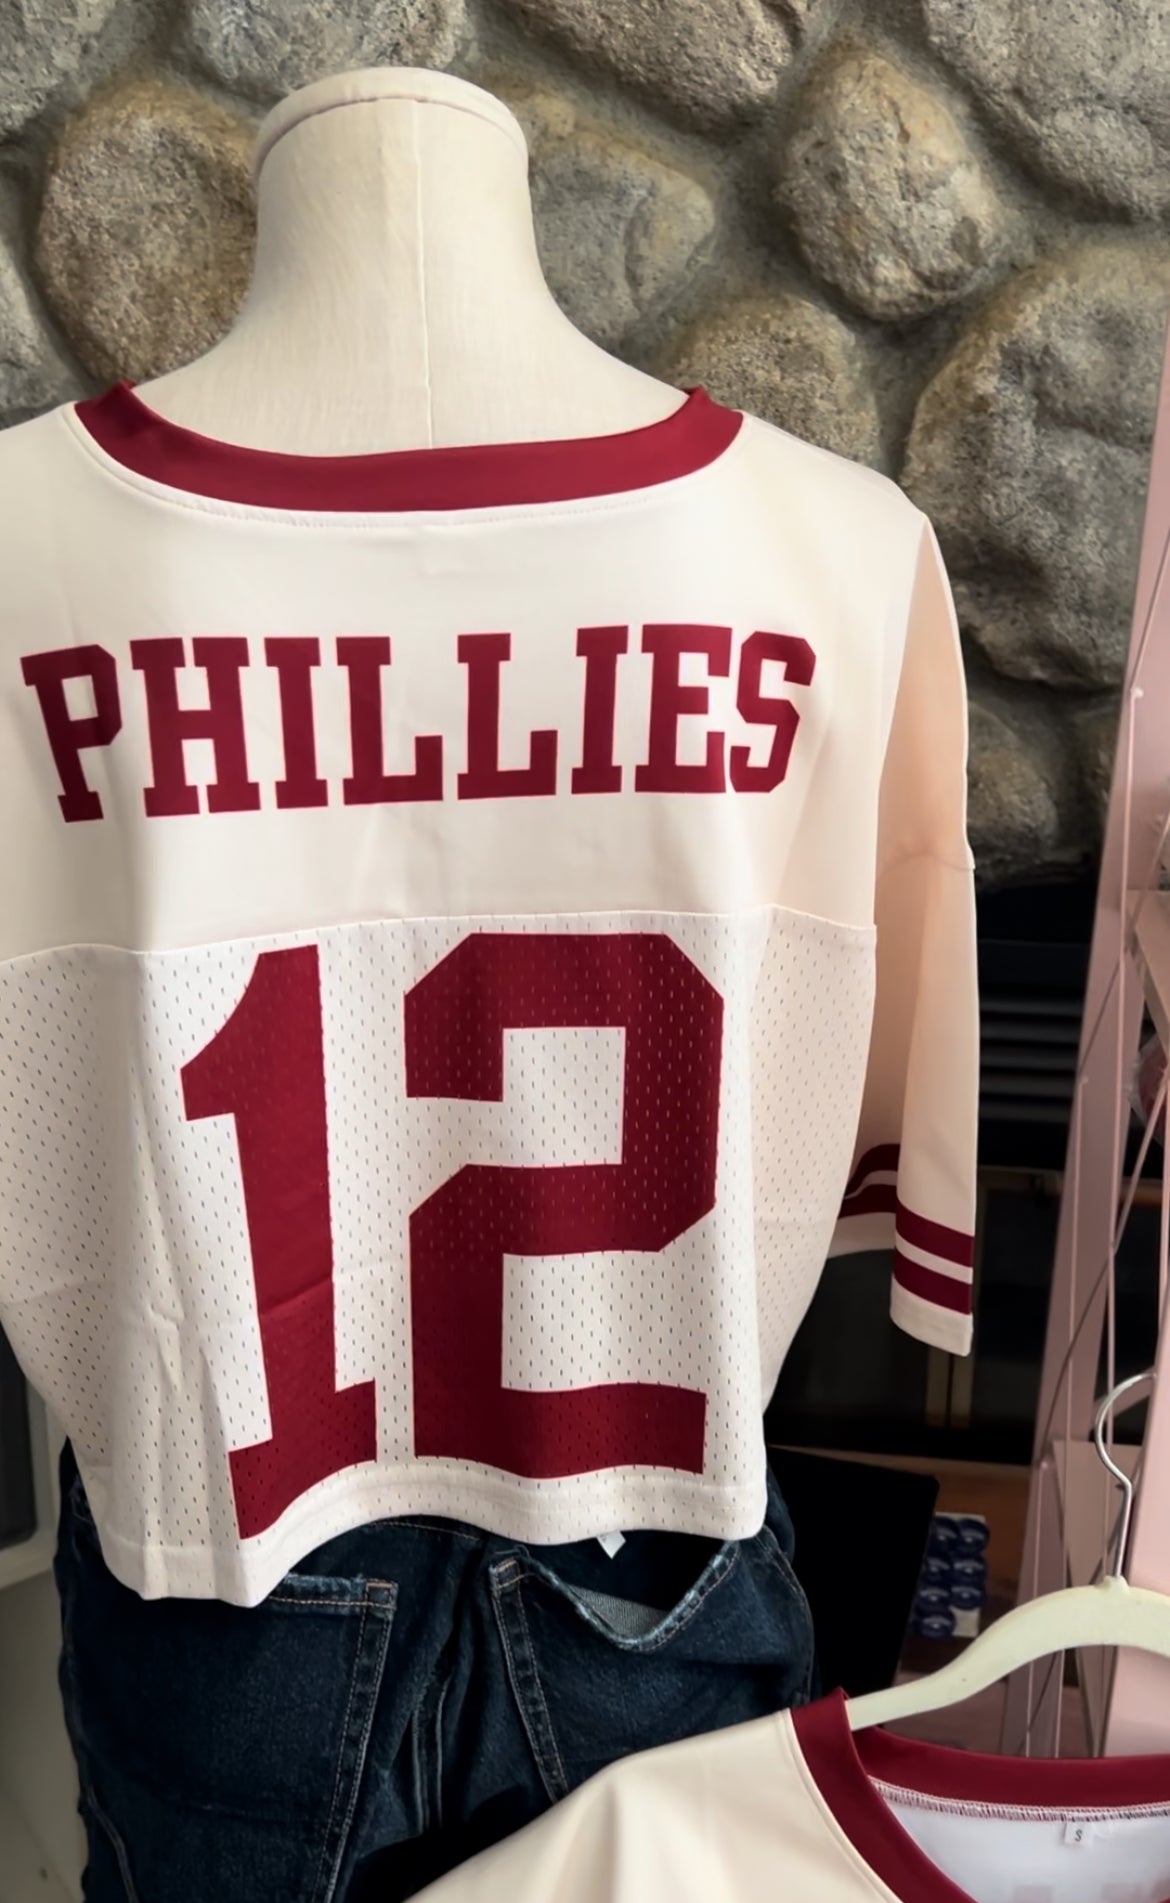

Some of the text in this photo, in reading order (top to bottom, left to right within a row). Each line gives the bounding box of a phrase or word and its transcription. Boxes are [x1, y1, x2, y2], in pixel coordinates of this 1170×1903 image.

[20, 624, 815, 823] PHILLIES
[181, 933, 724, 1539] 12
[1074, 1828, 1083, 1842] S
